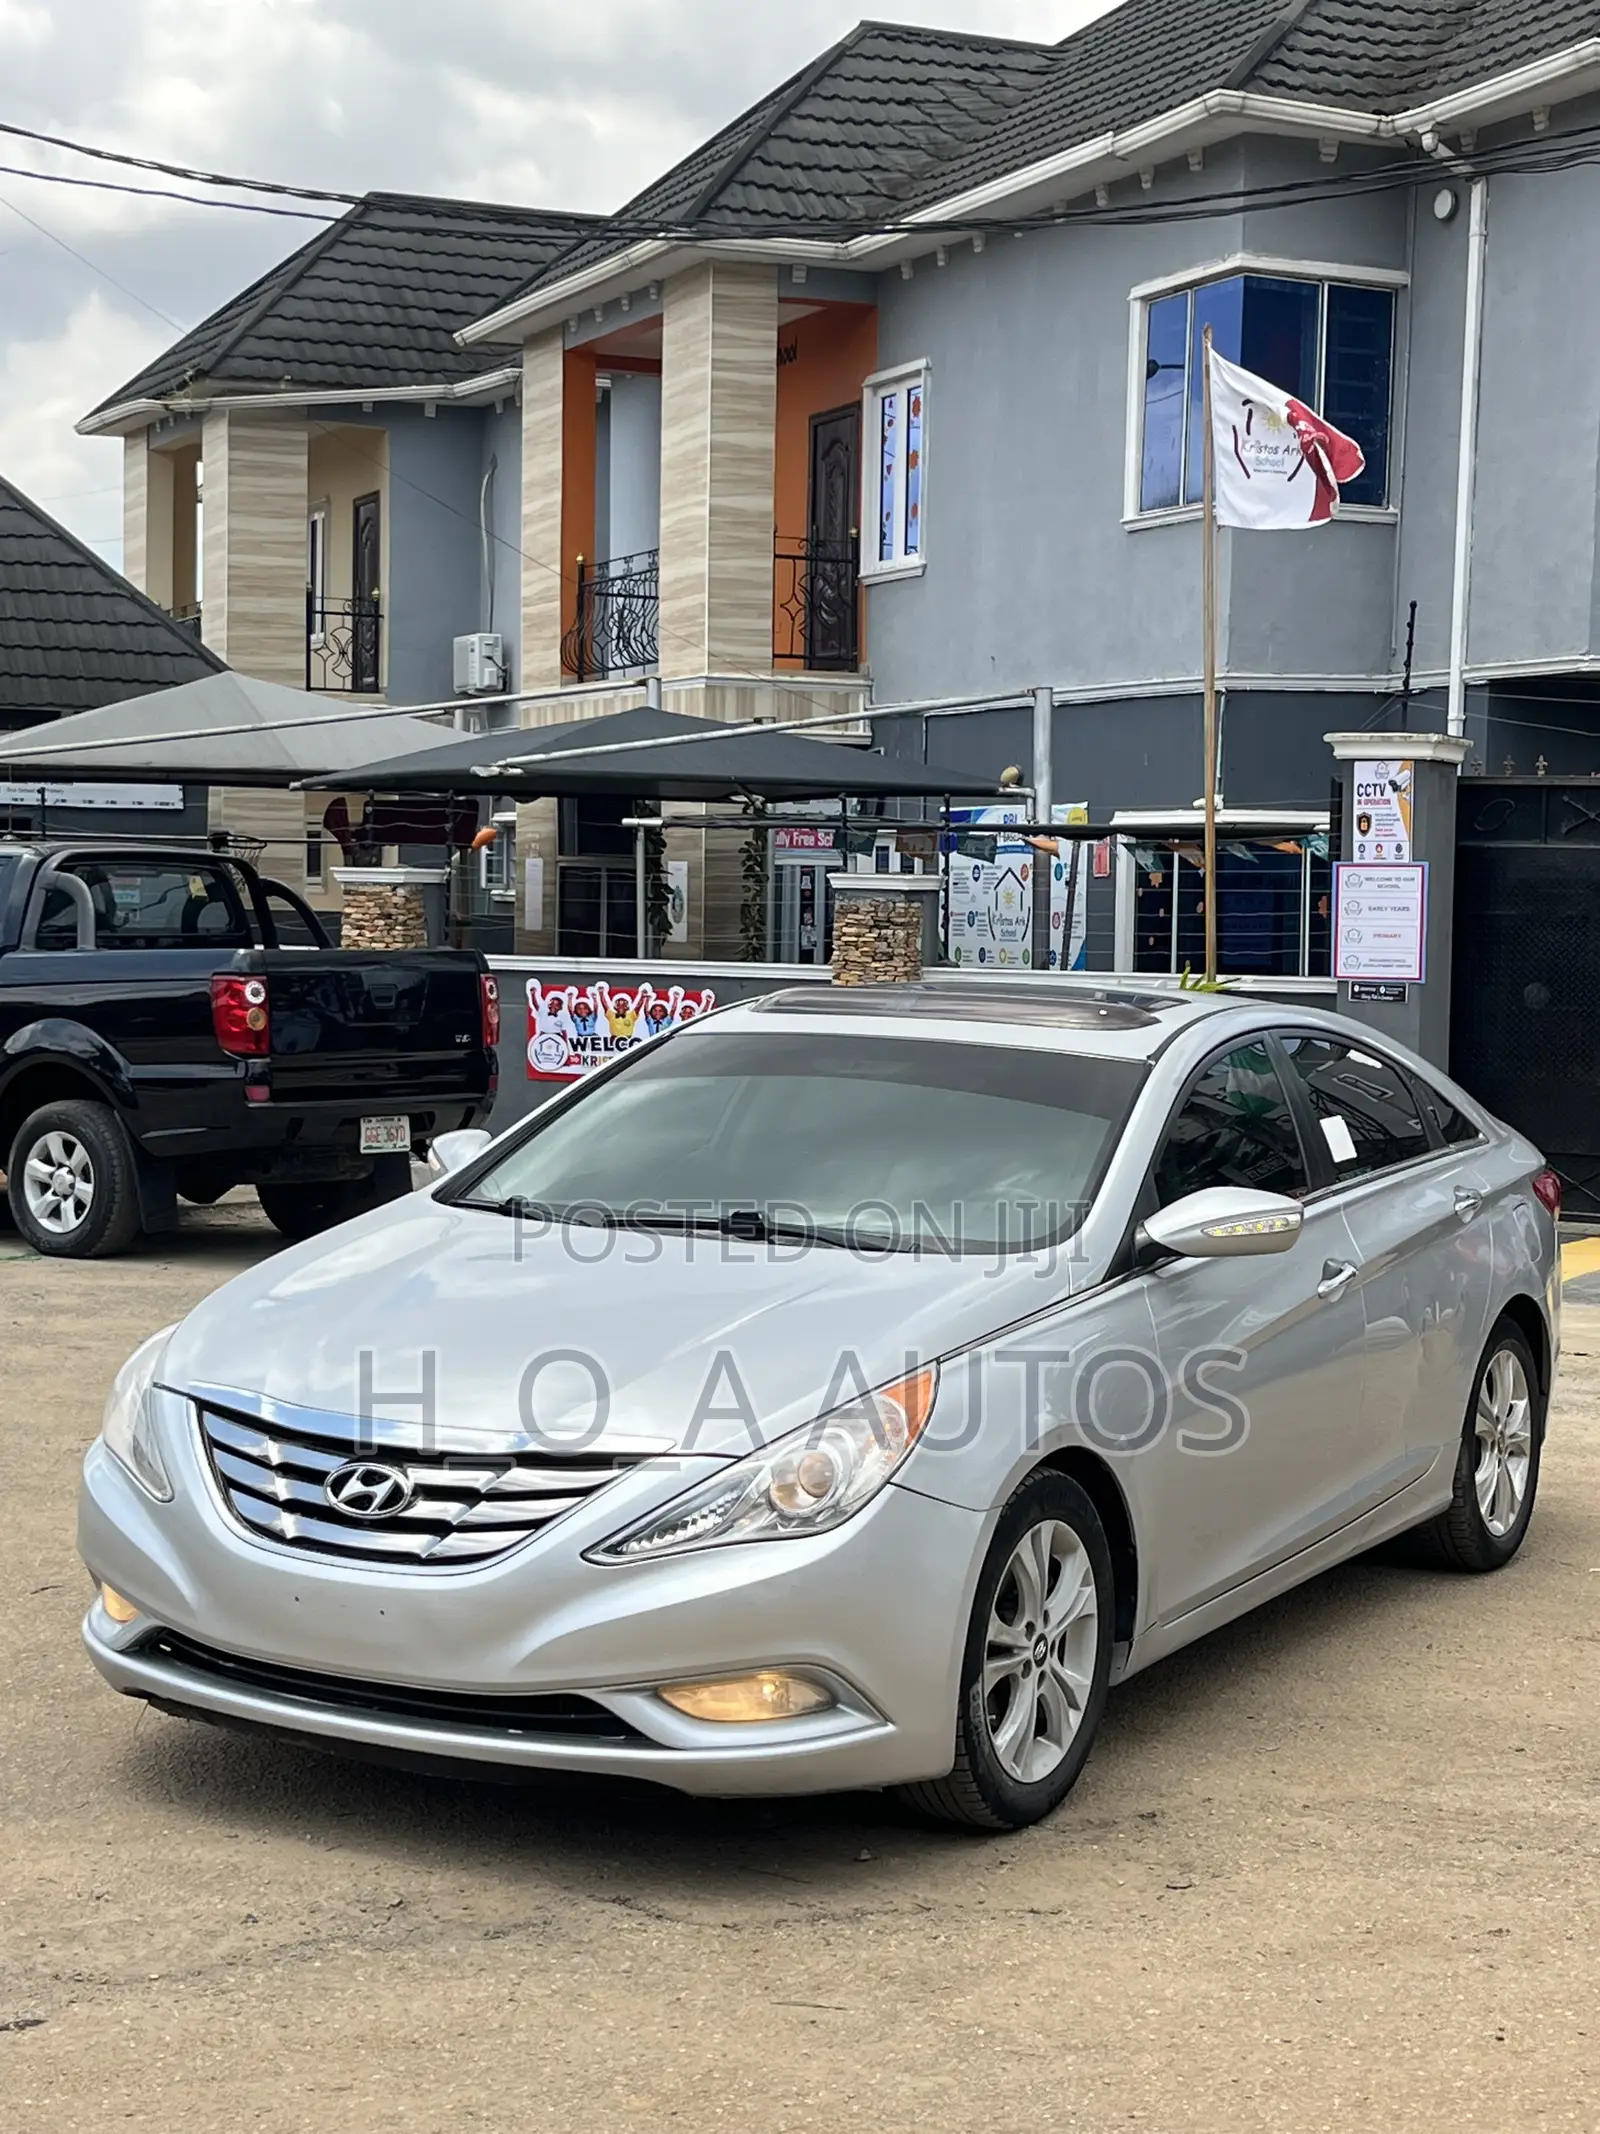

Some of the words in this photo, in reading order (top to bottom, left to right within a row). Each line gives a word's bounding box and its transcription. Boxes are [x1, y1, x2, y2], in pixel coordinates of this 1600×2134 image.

[1241, 437, 1280, 455] Kristos
[1356, 783, 1386, 797] CCTV
[793, 832, 815, 847] Free
